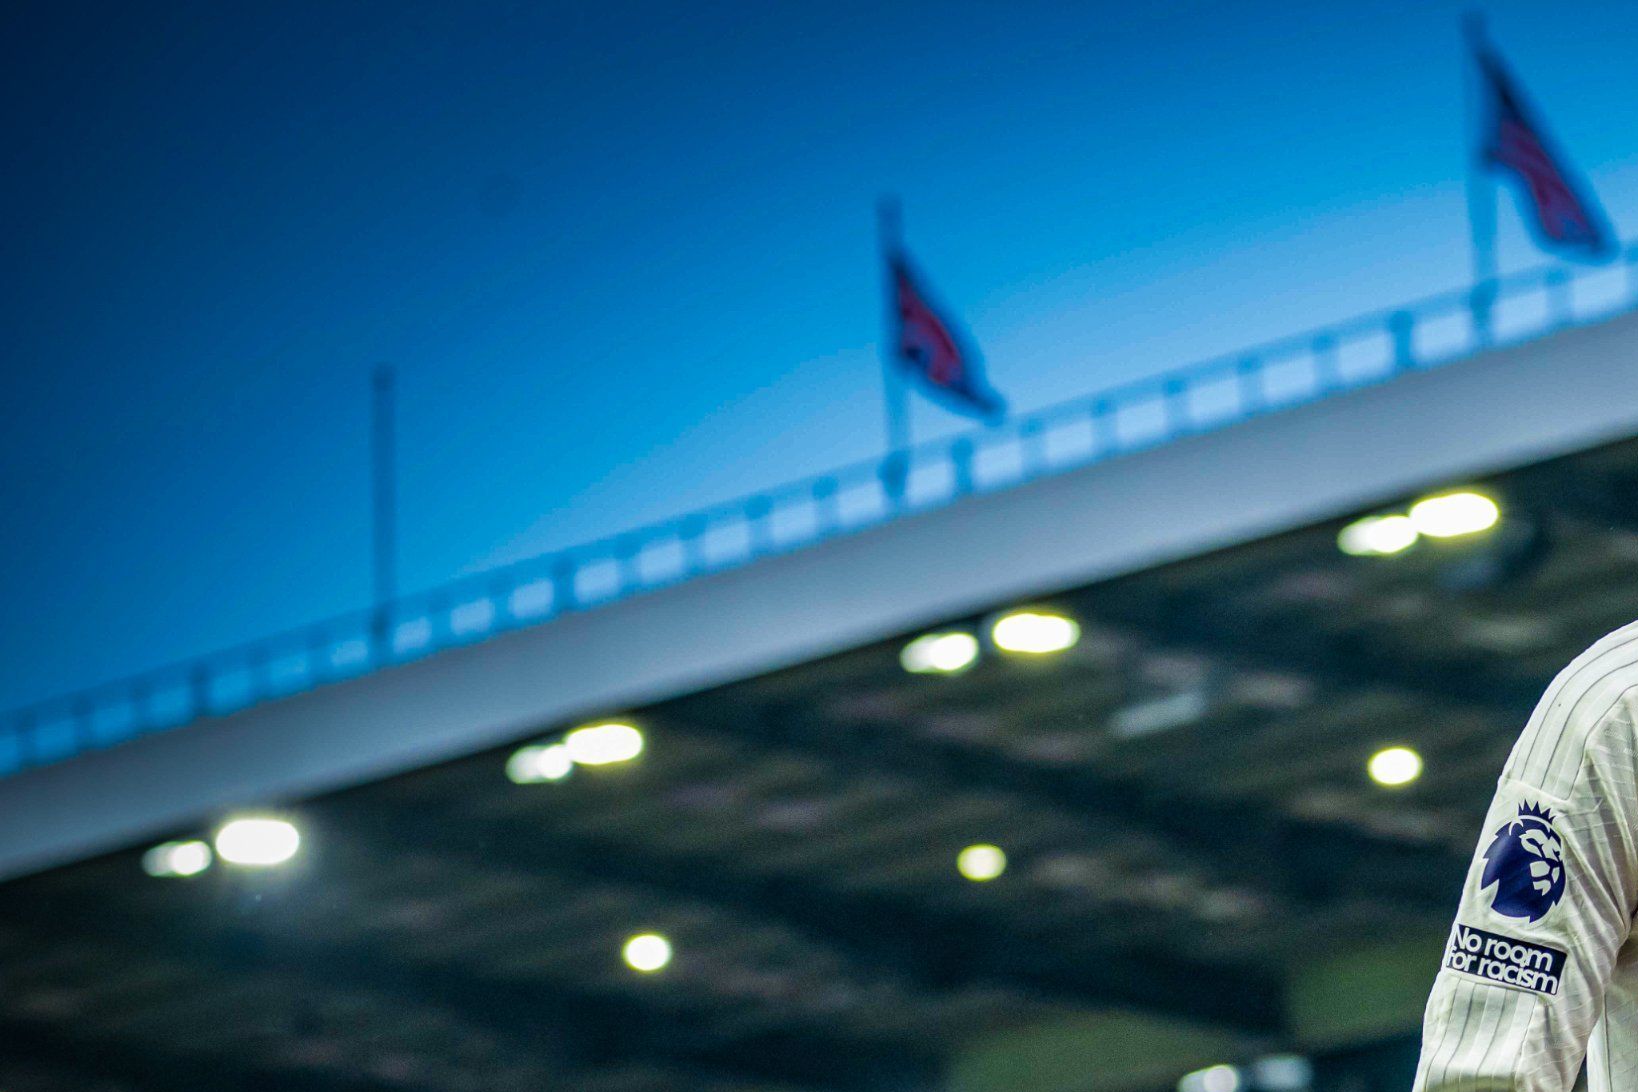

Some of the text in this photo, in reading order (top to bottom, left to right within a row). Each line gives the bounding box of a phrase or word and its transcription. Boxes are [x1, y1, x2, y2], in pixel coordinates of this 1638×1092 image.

[1446, 945, 1558, 995] for racism
[1451, 924, 1553, 972] No room
